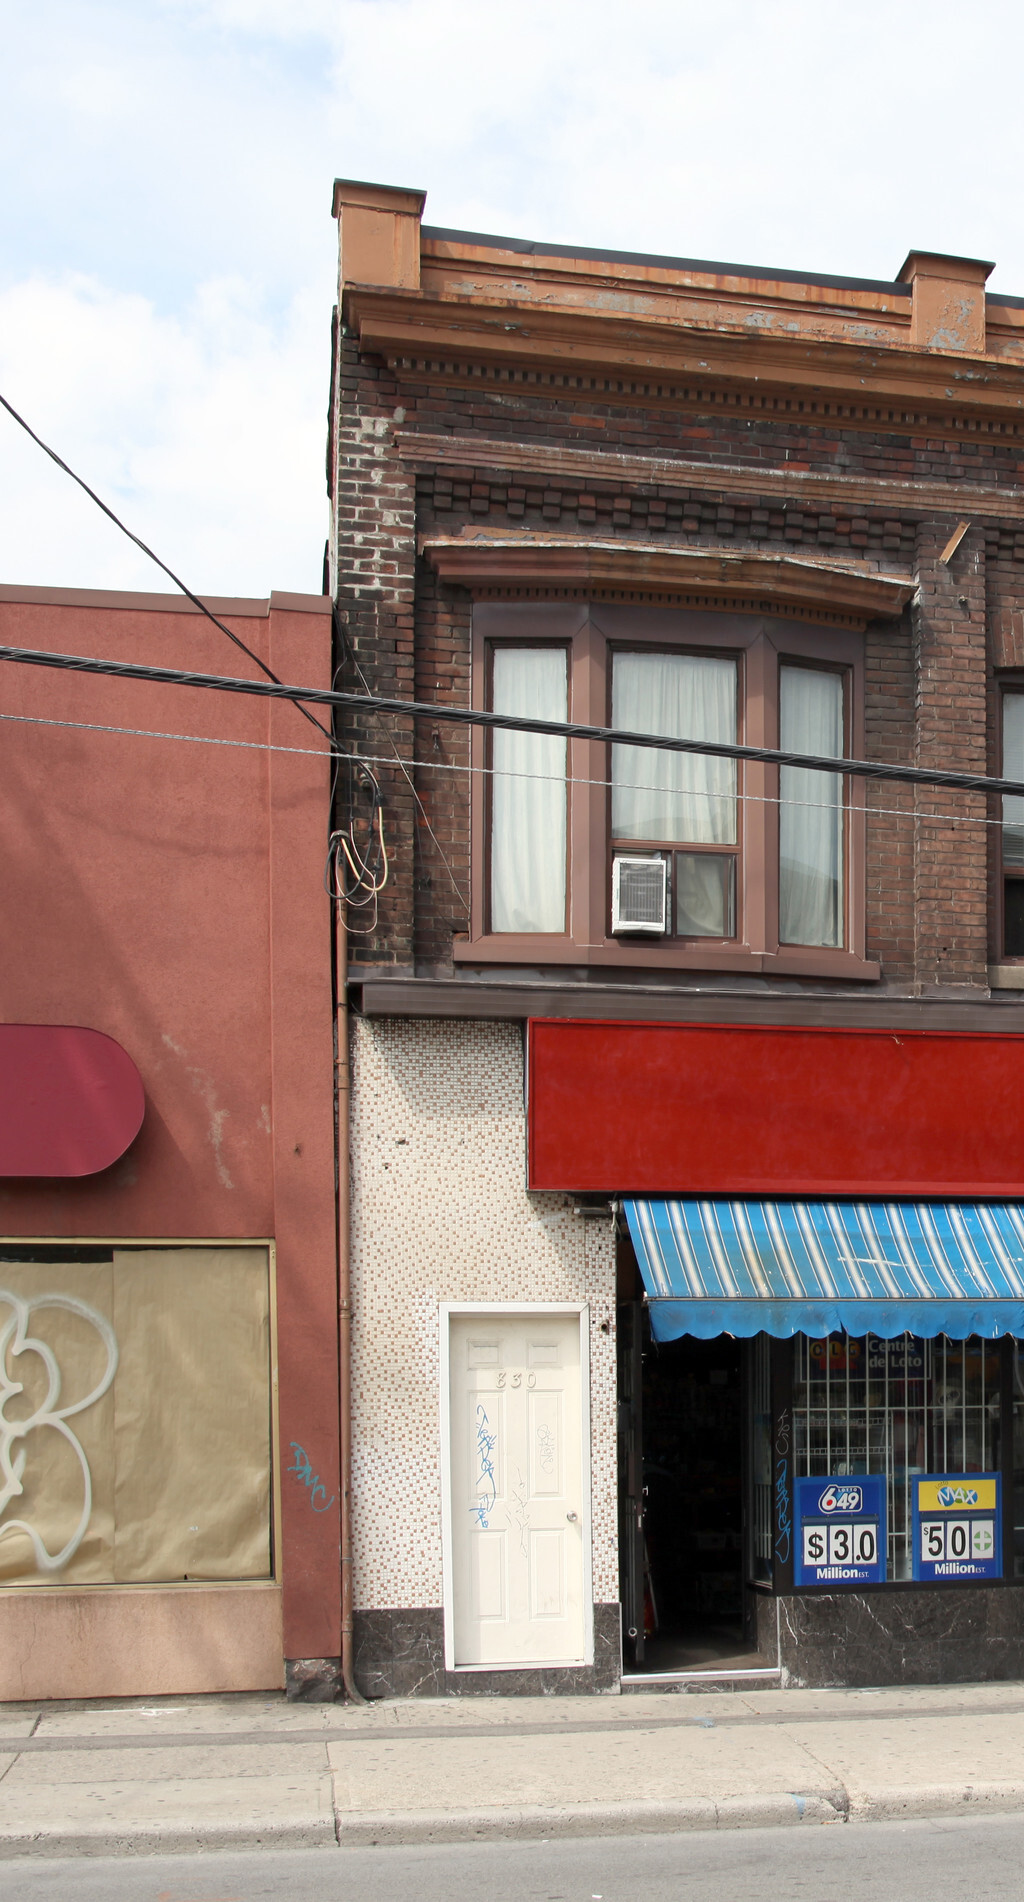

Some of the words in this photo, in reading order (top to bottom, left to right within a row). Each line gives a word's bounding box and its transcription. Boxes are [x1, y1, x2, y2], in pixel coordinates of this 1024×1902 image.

[869, 1340, 915, 1353] Centre
[869, 1355, 886, 1368] de
[891, 1355, 922, 1368] Loto
[495, 1370, 538, 1389] 830
[935, 1480, 949, 1490] Lotto
[938, 1486, 977, 1506] MAX
[923, 1526, 966, 1557] $50
[816, 1566, 858, 1579] Million
[934, 1563, 975, 1575] Million
